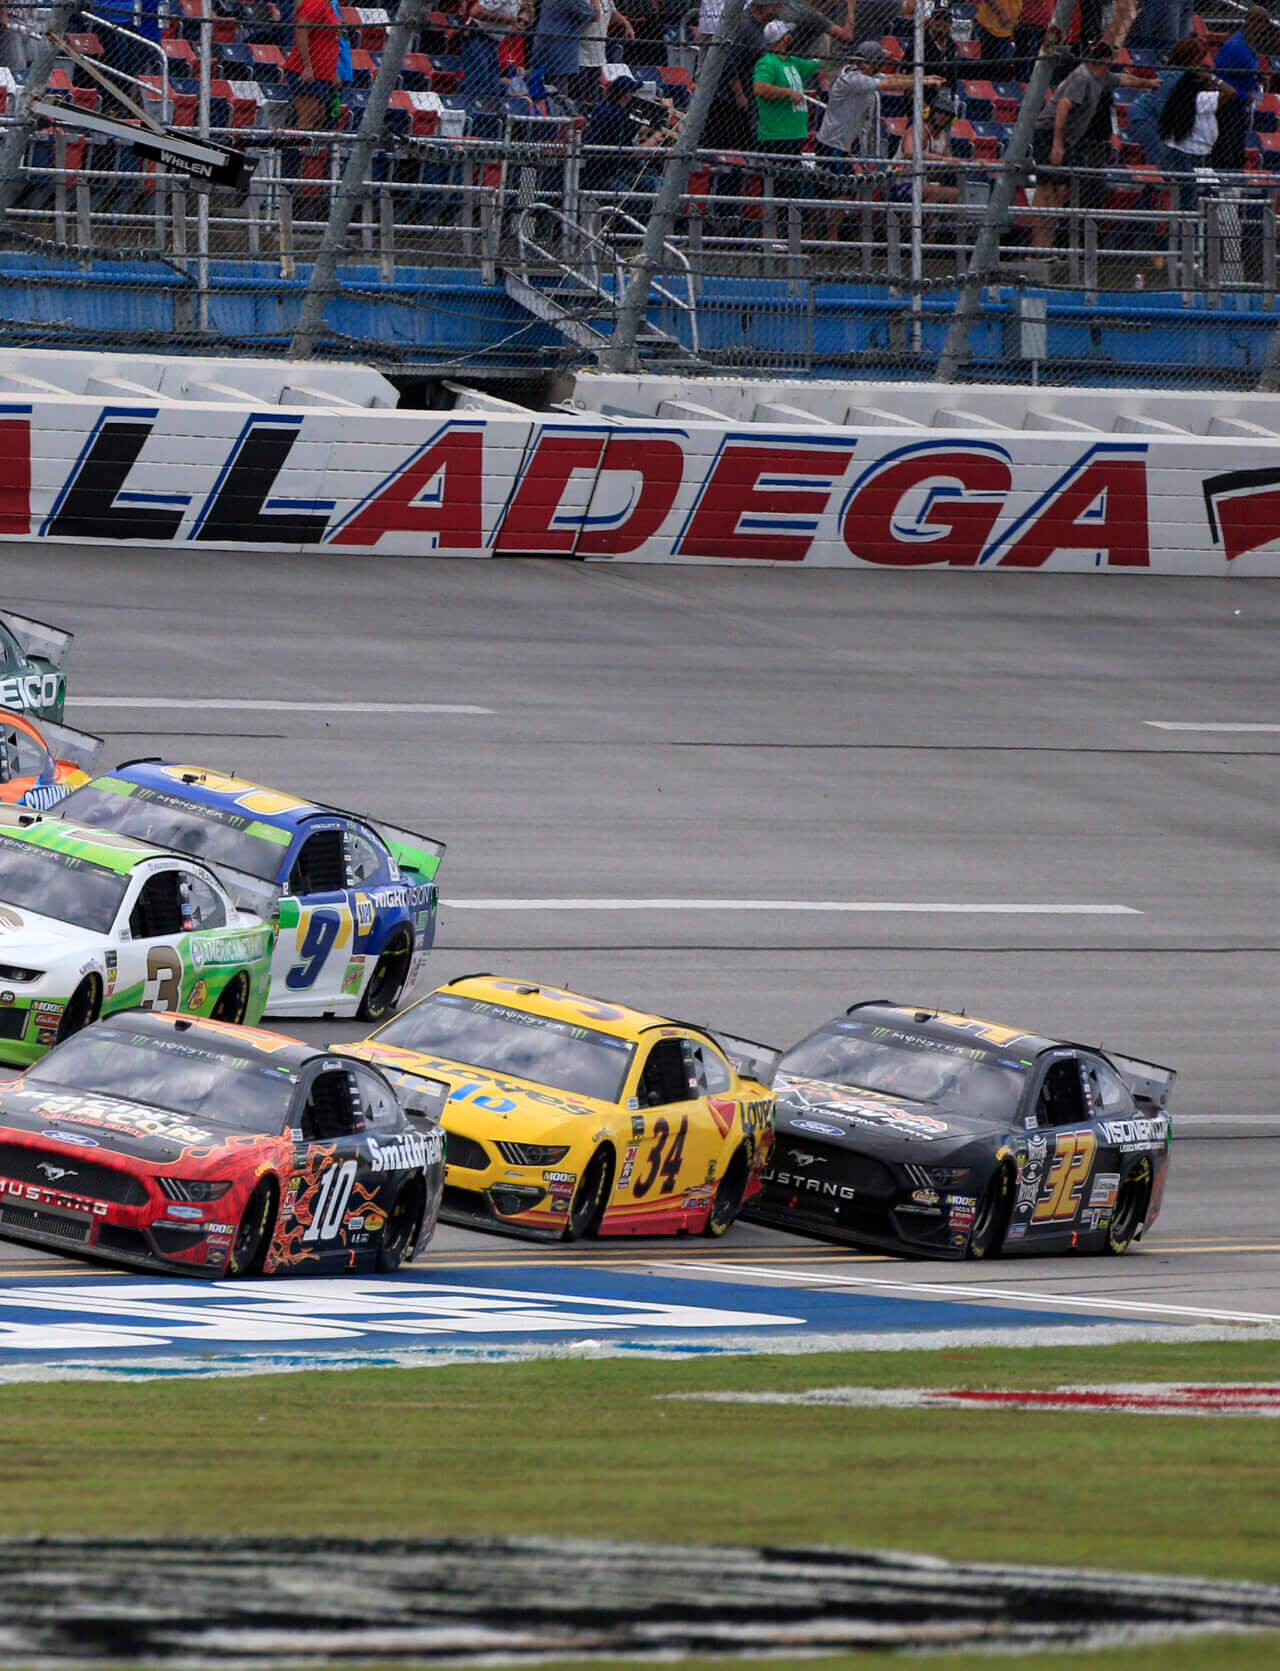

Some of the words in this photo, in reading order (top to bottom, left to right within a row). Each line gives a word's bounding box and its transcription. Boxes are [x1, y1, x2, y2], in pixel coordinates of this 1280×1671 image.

[160, 150, 213, 178] WHELEN
[157, 793, 224, 819] MONSTER
[285, 906, 341, 992] 9
[141, 945, 183, 1013] 3
[492, 1007, 567, 1032] MONSTER
[152, 1039, 225, 1062] MONSTER
[891, 1032, 965, 1054] MONSTER
[633, 1114, 689, 1199] 34
[543, 1171, 577, 1183] MOOG
[759, 1166, 856, 1200] USTANG
[1030, 1128, 1098, 1226] 32
[302, 1159, 358, 1241] 10
[946, 1194, 976, 1206] MOOG
[202, 1222, 233, 1235] MOOG
